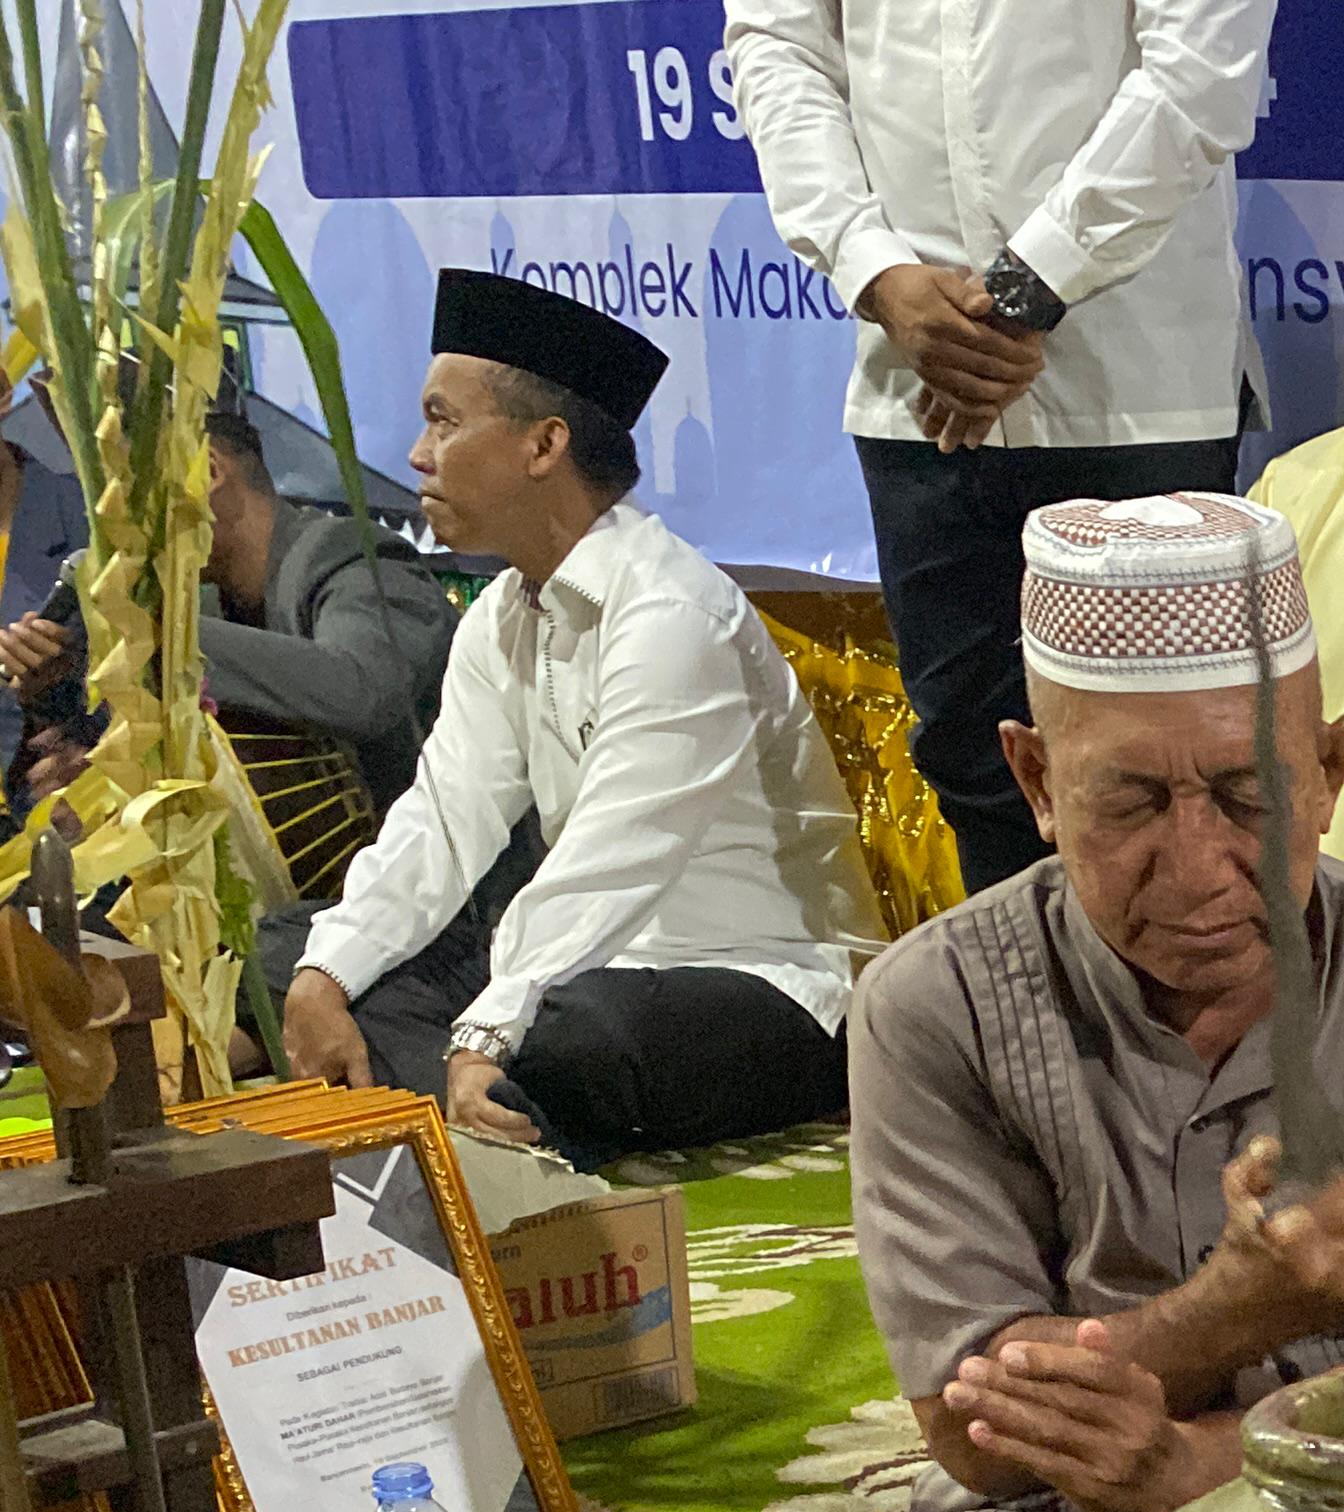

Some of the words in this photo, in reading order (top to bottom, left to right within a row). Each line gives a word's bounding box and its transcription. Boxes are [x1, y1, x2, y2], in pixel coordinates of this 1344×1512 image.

[626, 46, 693, 141] 19
[228, 1316, 362, 1368] KESULTANAN
[365, 1295, 446, 1331] BANJAR
